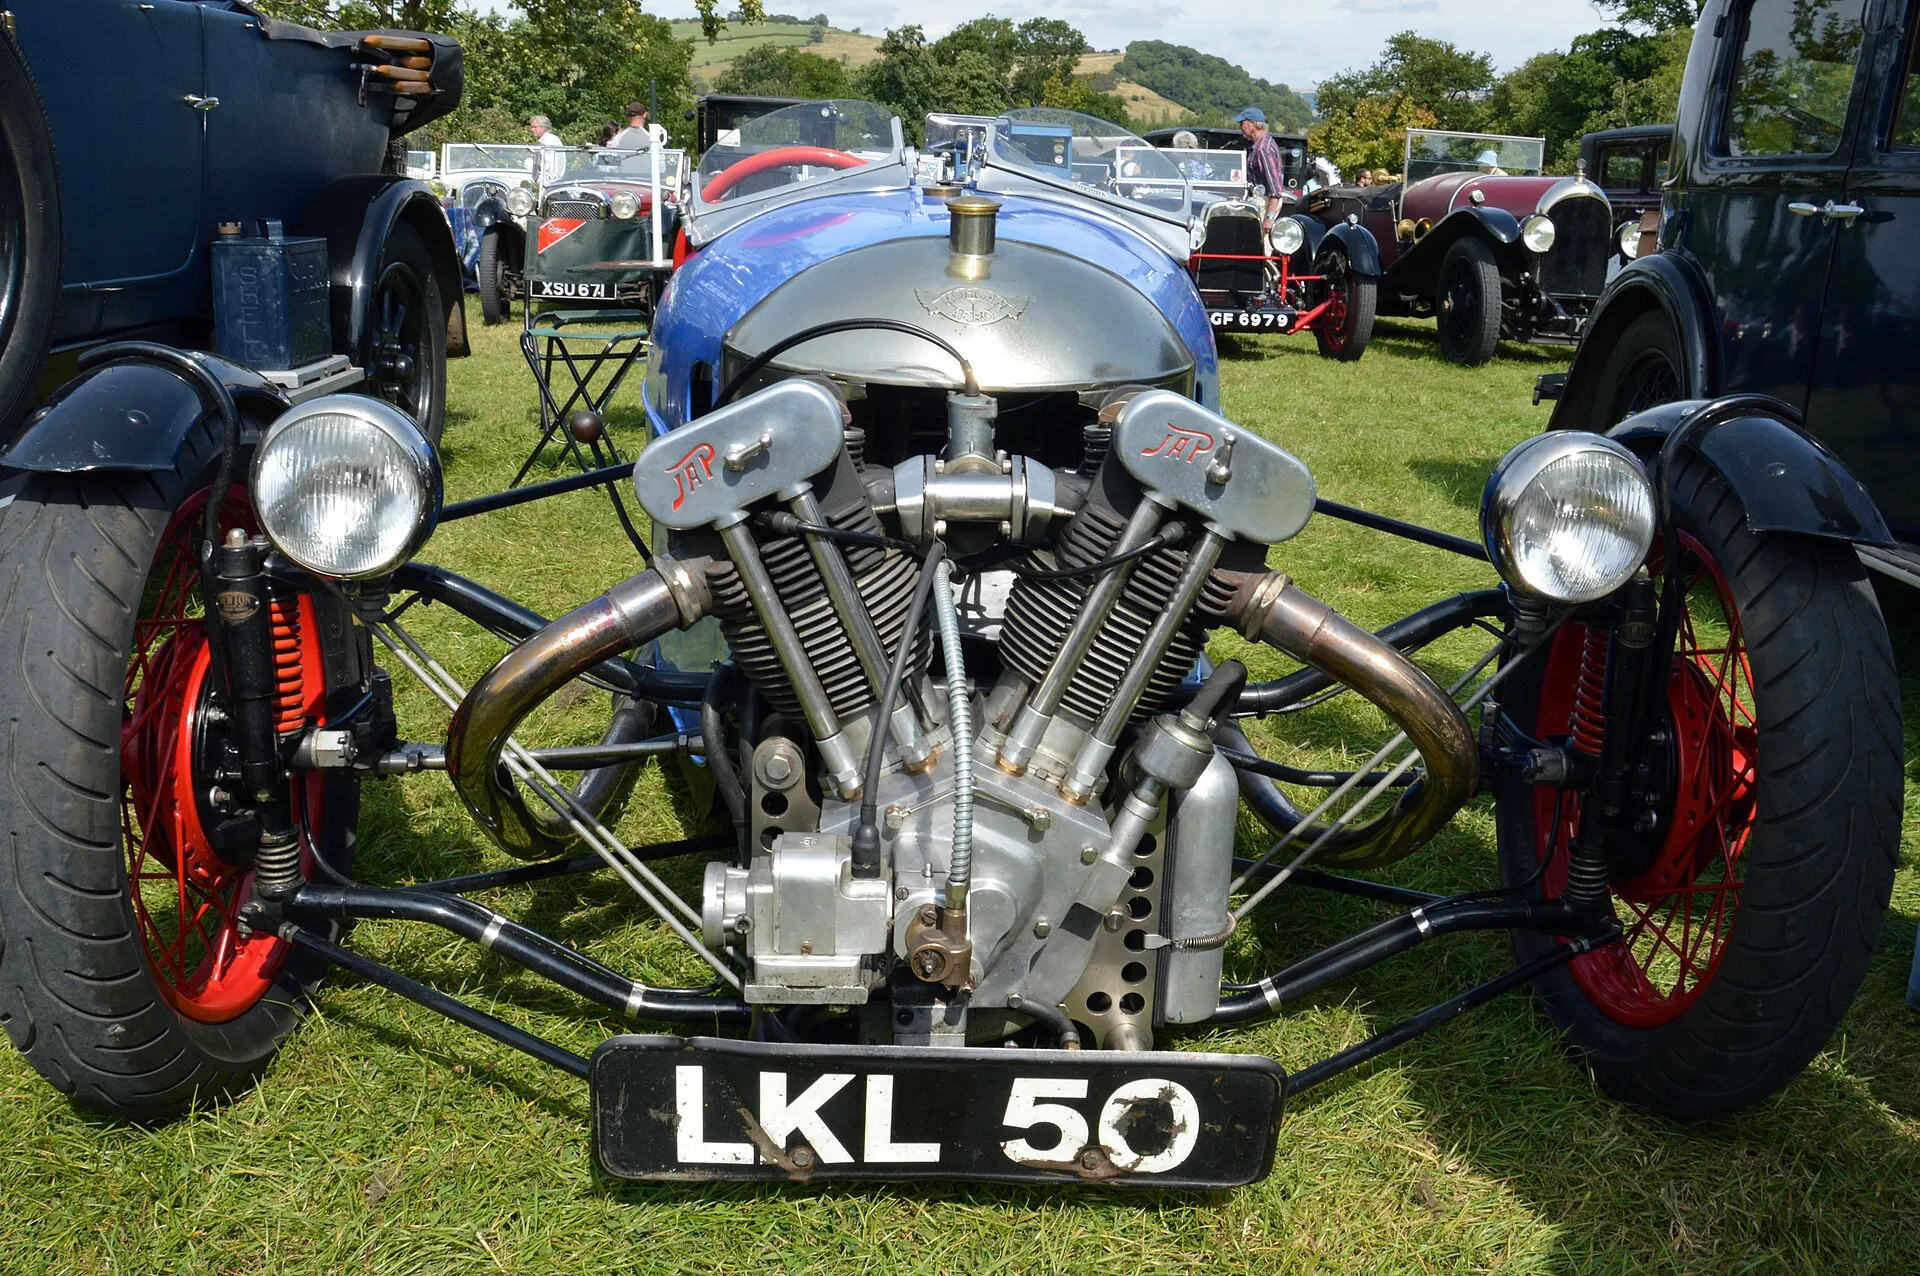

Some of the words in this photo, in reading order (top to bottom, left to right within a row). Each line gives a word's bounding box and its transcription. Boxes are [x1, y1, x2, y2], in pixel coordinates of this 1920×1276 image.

[541, 281, 575, 296] XSU
[578, 283, 605, 298] 671
[941, 289, 1008, 311] MORGAN
[1210, 312, 1234, 326] GF
[1238, 313, 1289, 327] 6979
[1141, 423, 1214, 463] JAP
[664, 442, 716, 512] JAP
[674, 1064, 941, 1165] LKL
[1000, 1076, 1200, 1173] 50
